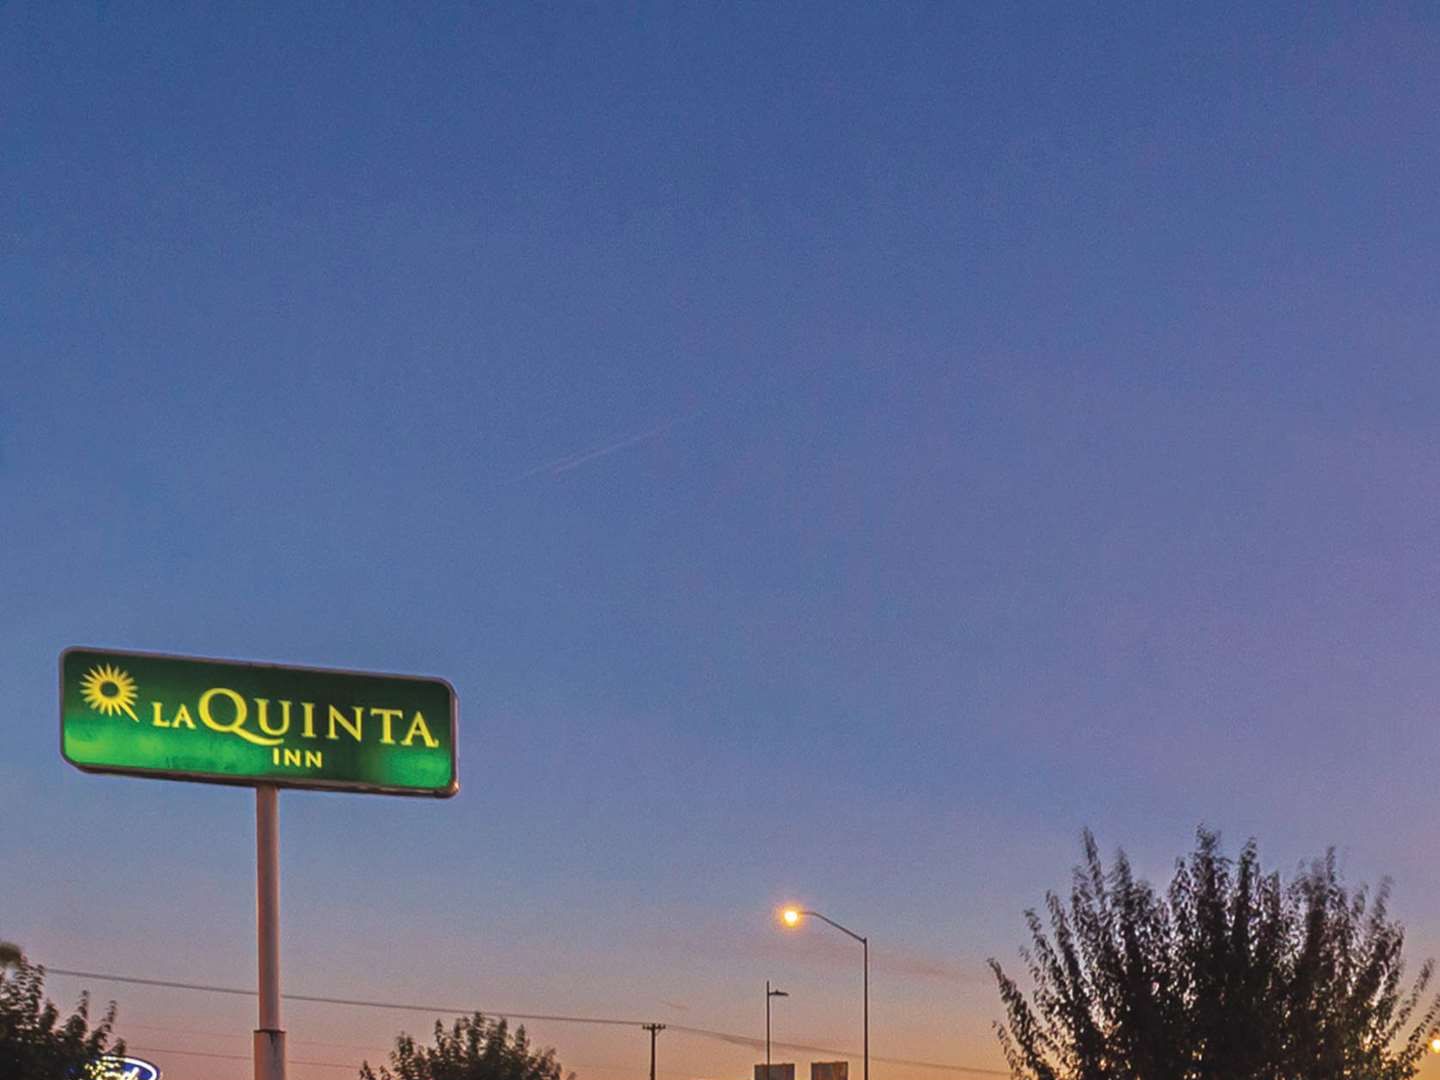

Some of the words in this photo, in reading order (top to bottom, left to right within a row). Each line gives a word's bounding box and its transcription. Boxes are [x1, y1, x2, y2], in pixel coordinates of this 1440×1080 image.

[152, 701, 197, 730] LA
[198, 687, 440, 748] QUINTA
[272, 747, 323, 768] INN
